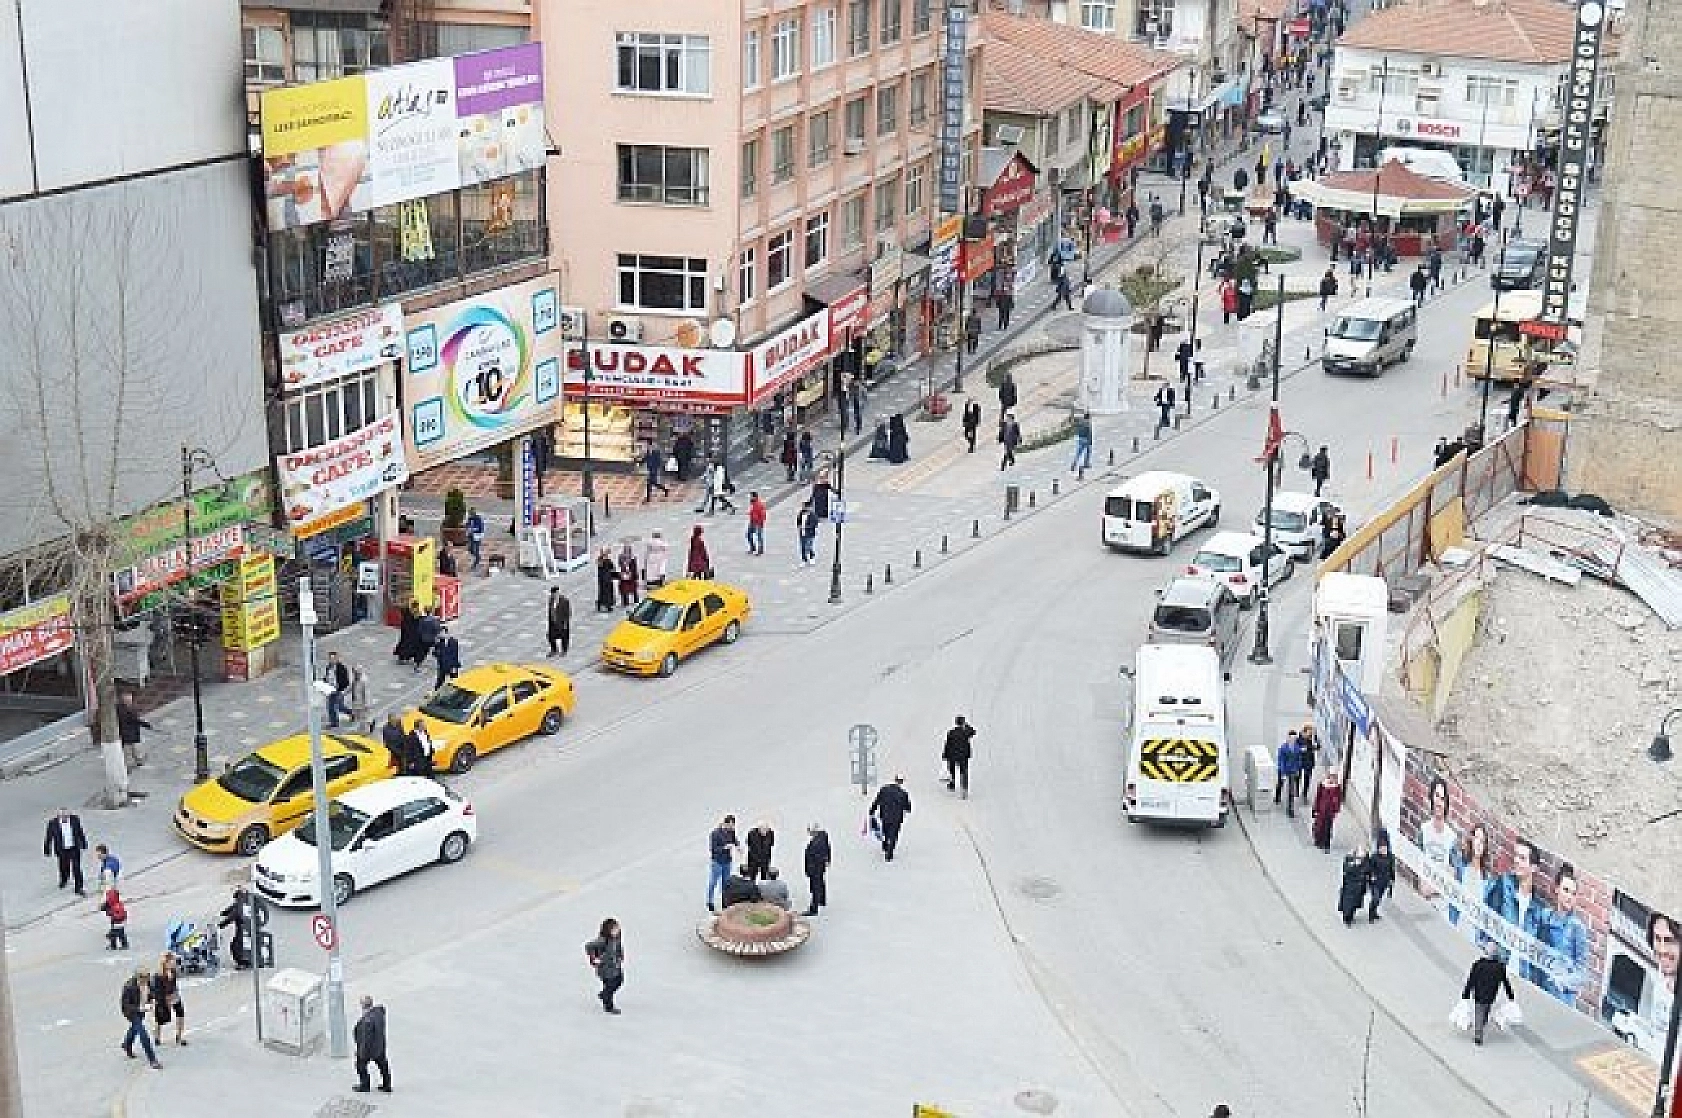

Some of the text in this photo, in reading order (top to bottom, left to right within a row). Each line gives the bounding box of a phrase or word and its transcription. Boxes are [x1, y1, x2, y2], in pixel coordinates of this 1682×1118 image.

[1417, 121, 1461, 137] BOSCH
[766, 320, 820, 369] BUDAK
[567, 348, 705, 376] BUDAK
[312, 450, 373, 485] CAFE
